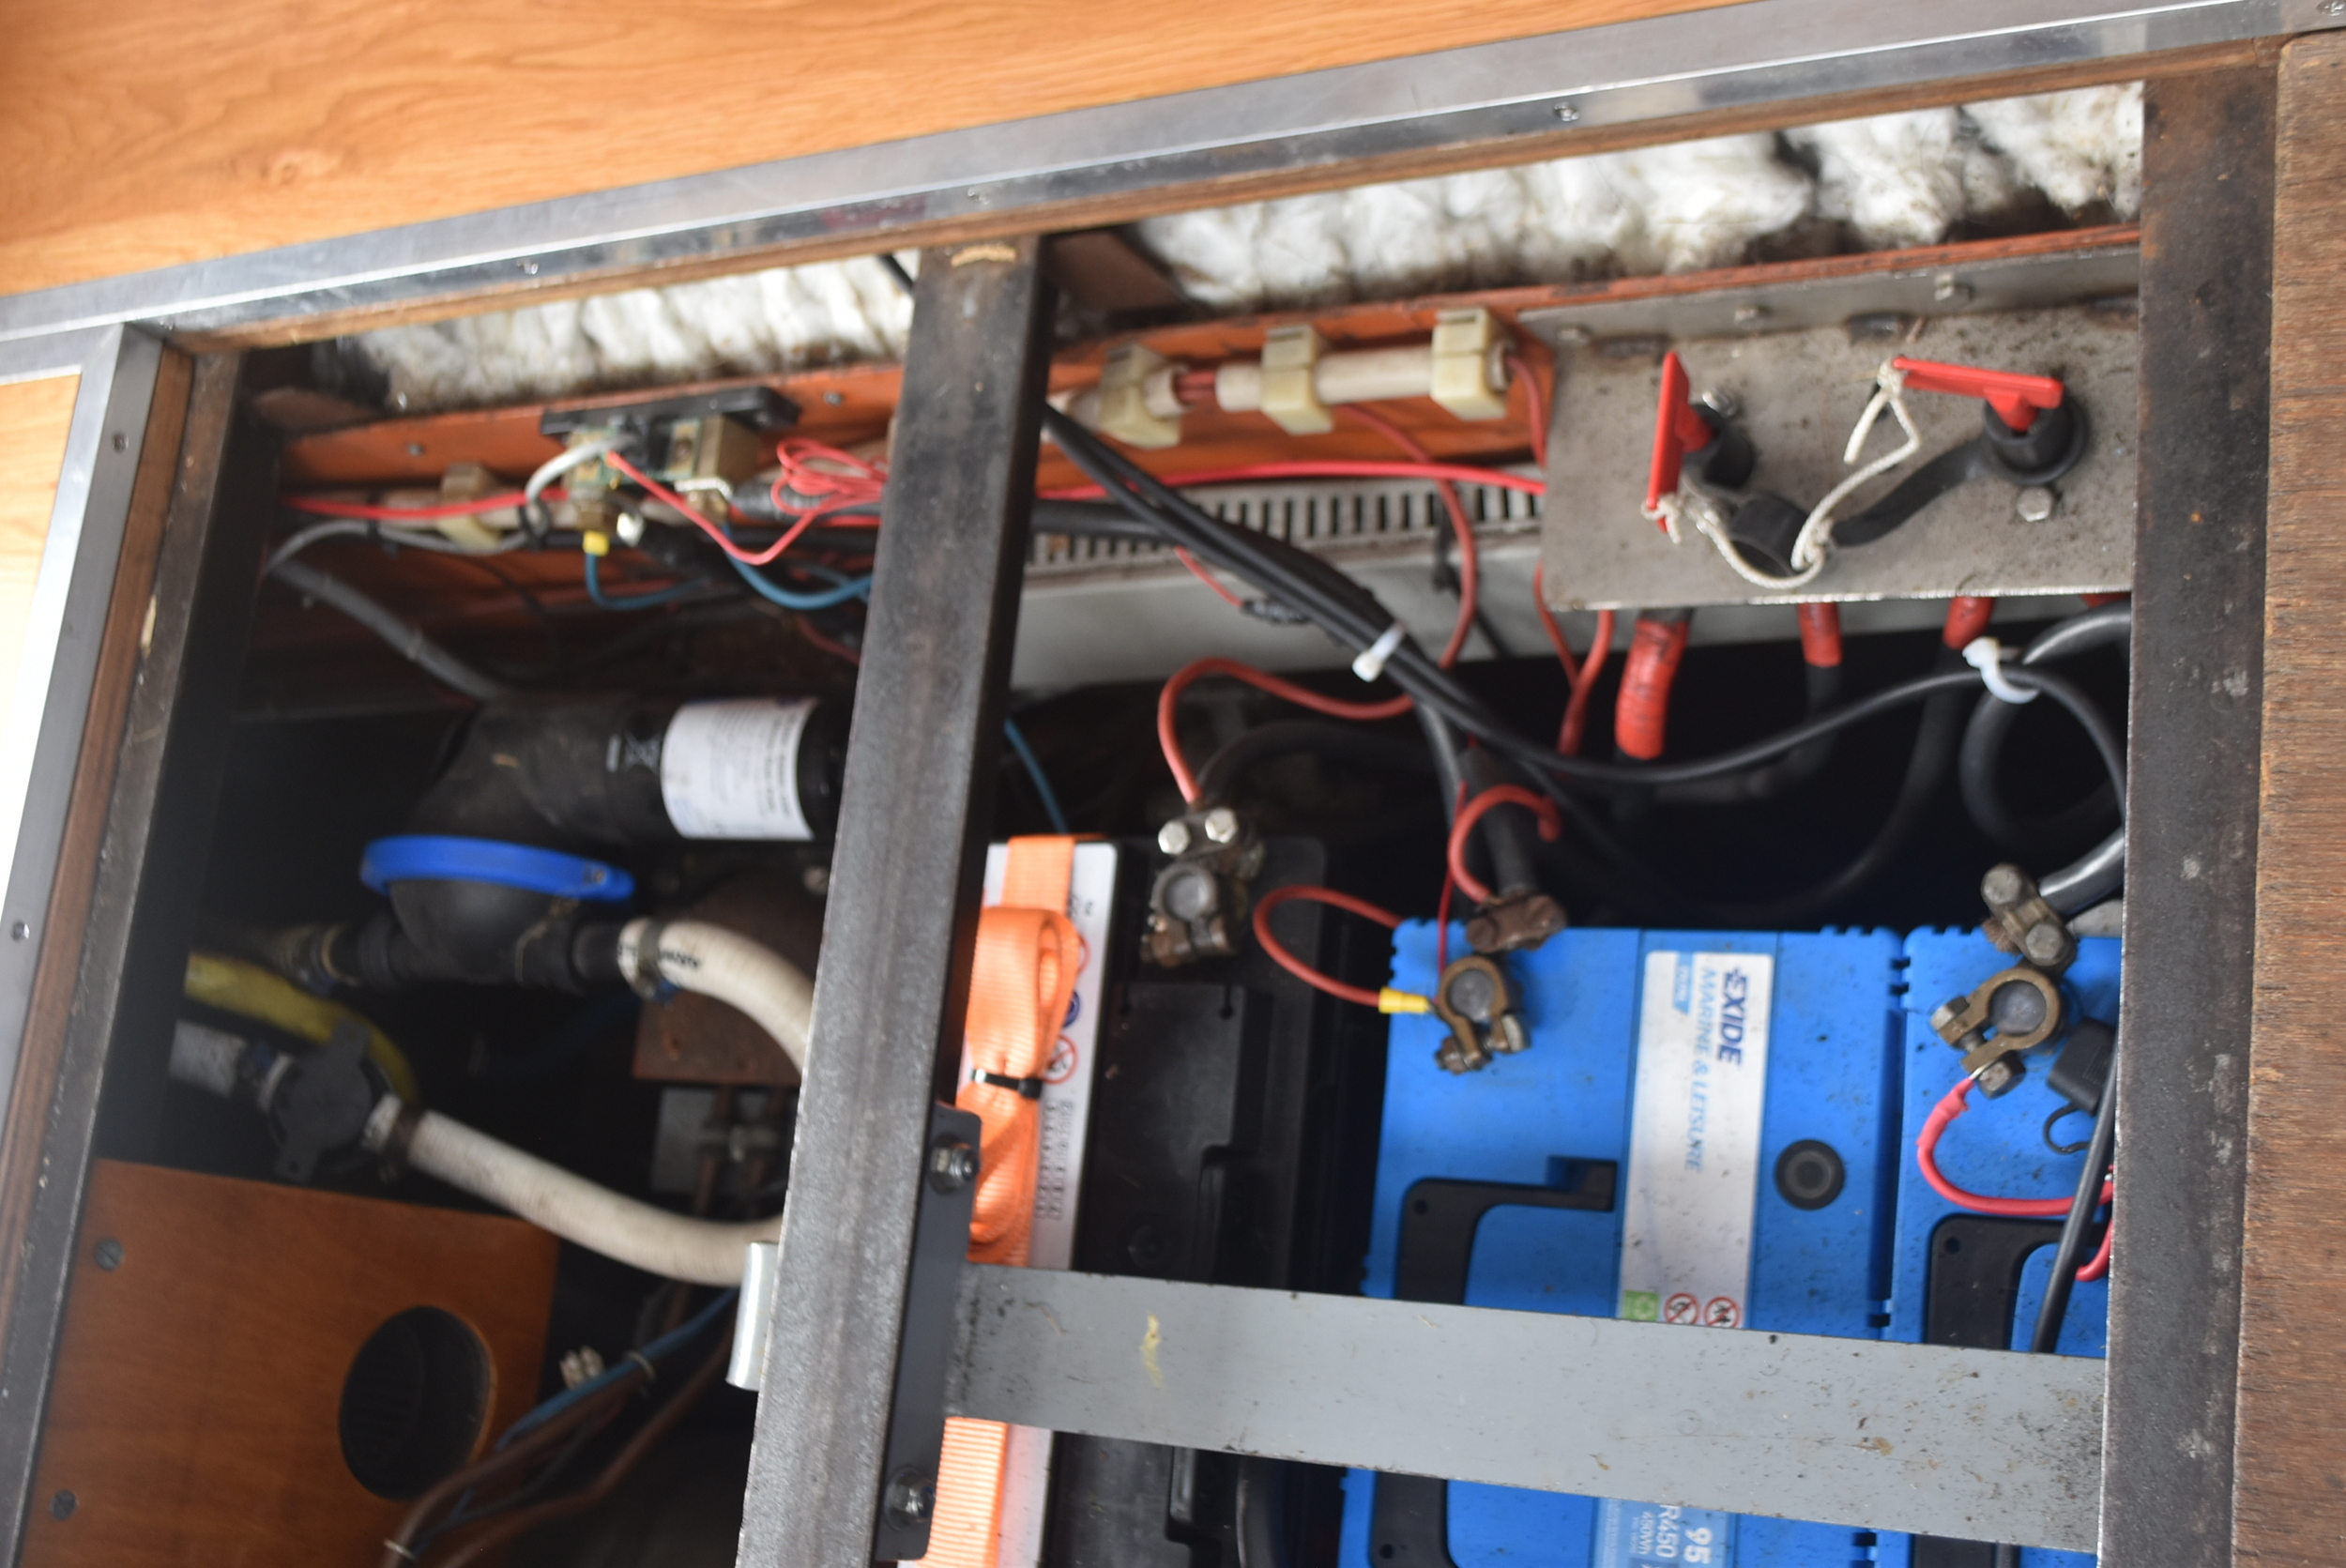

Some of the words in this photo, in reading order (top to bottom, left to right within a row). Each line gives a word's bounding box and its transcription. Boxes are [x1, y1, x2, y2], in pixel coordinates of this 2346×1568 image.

[1697, 968, 1716, 1058] MARINE
[1718, 967, 1747, 1064] EXIDE
[1693, 1058, 1711, 1074] &
[1686, 1081, 1708, 1172] LEISURE
[1684, 1527, 1712, 1563] 95
